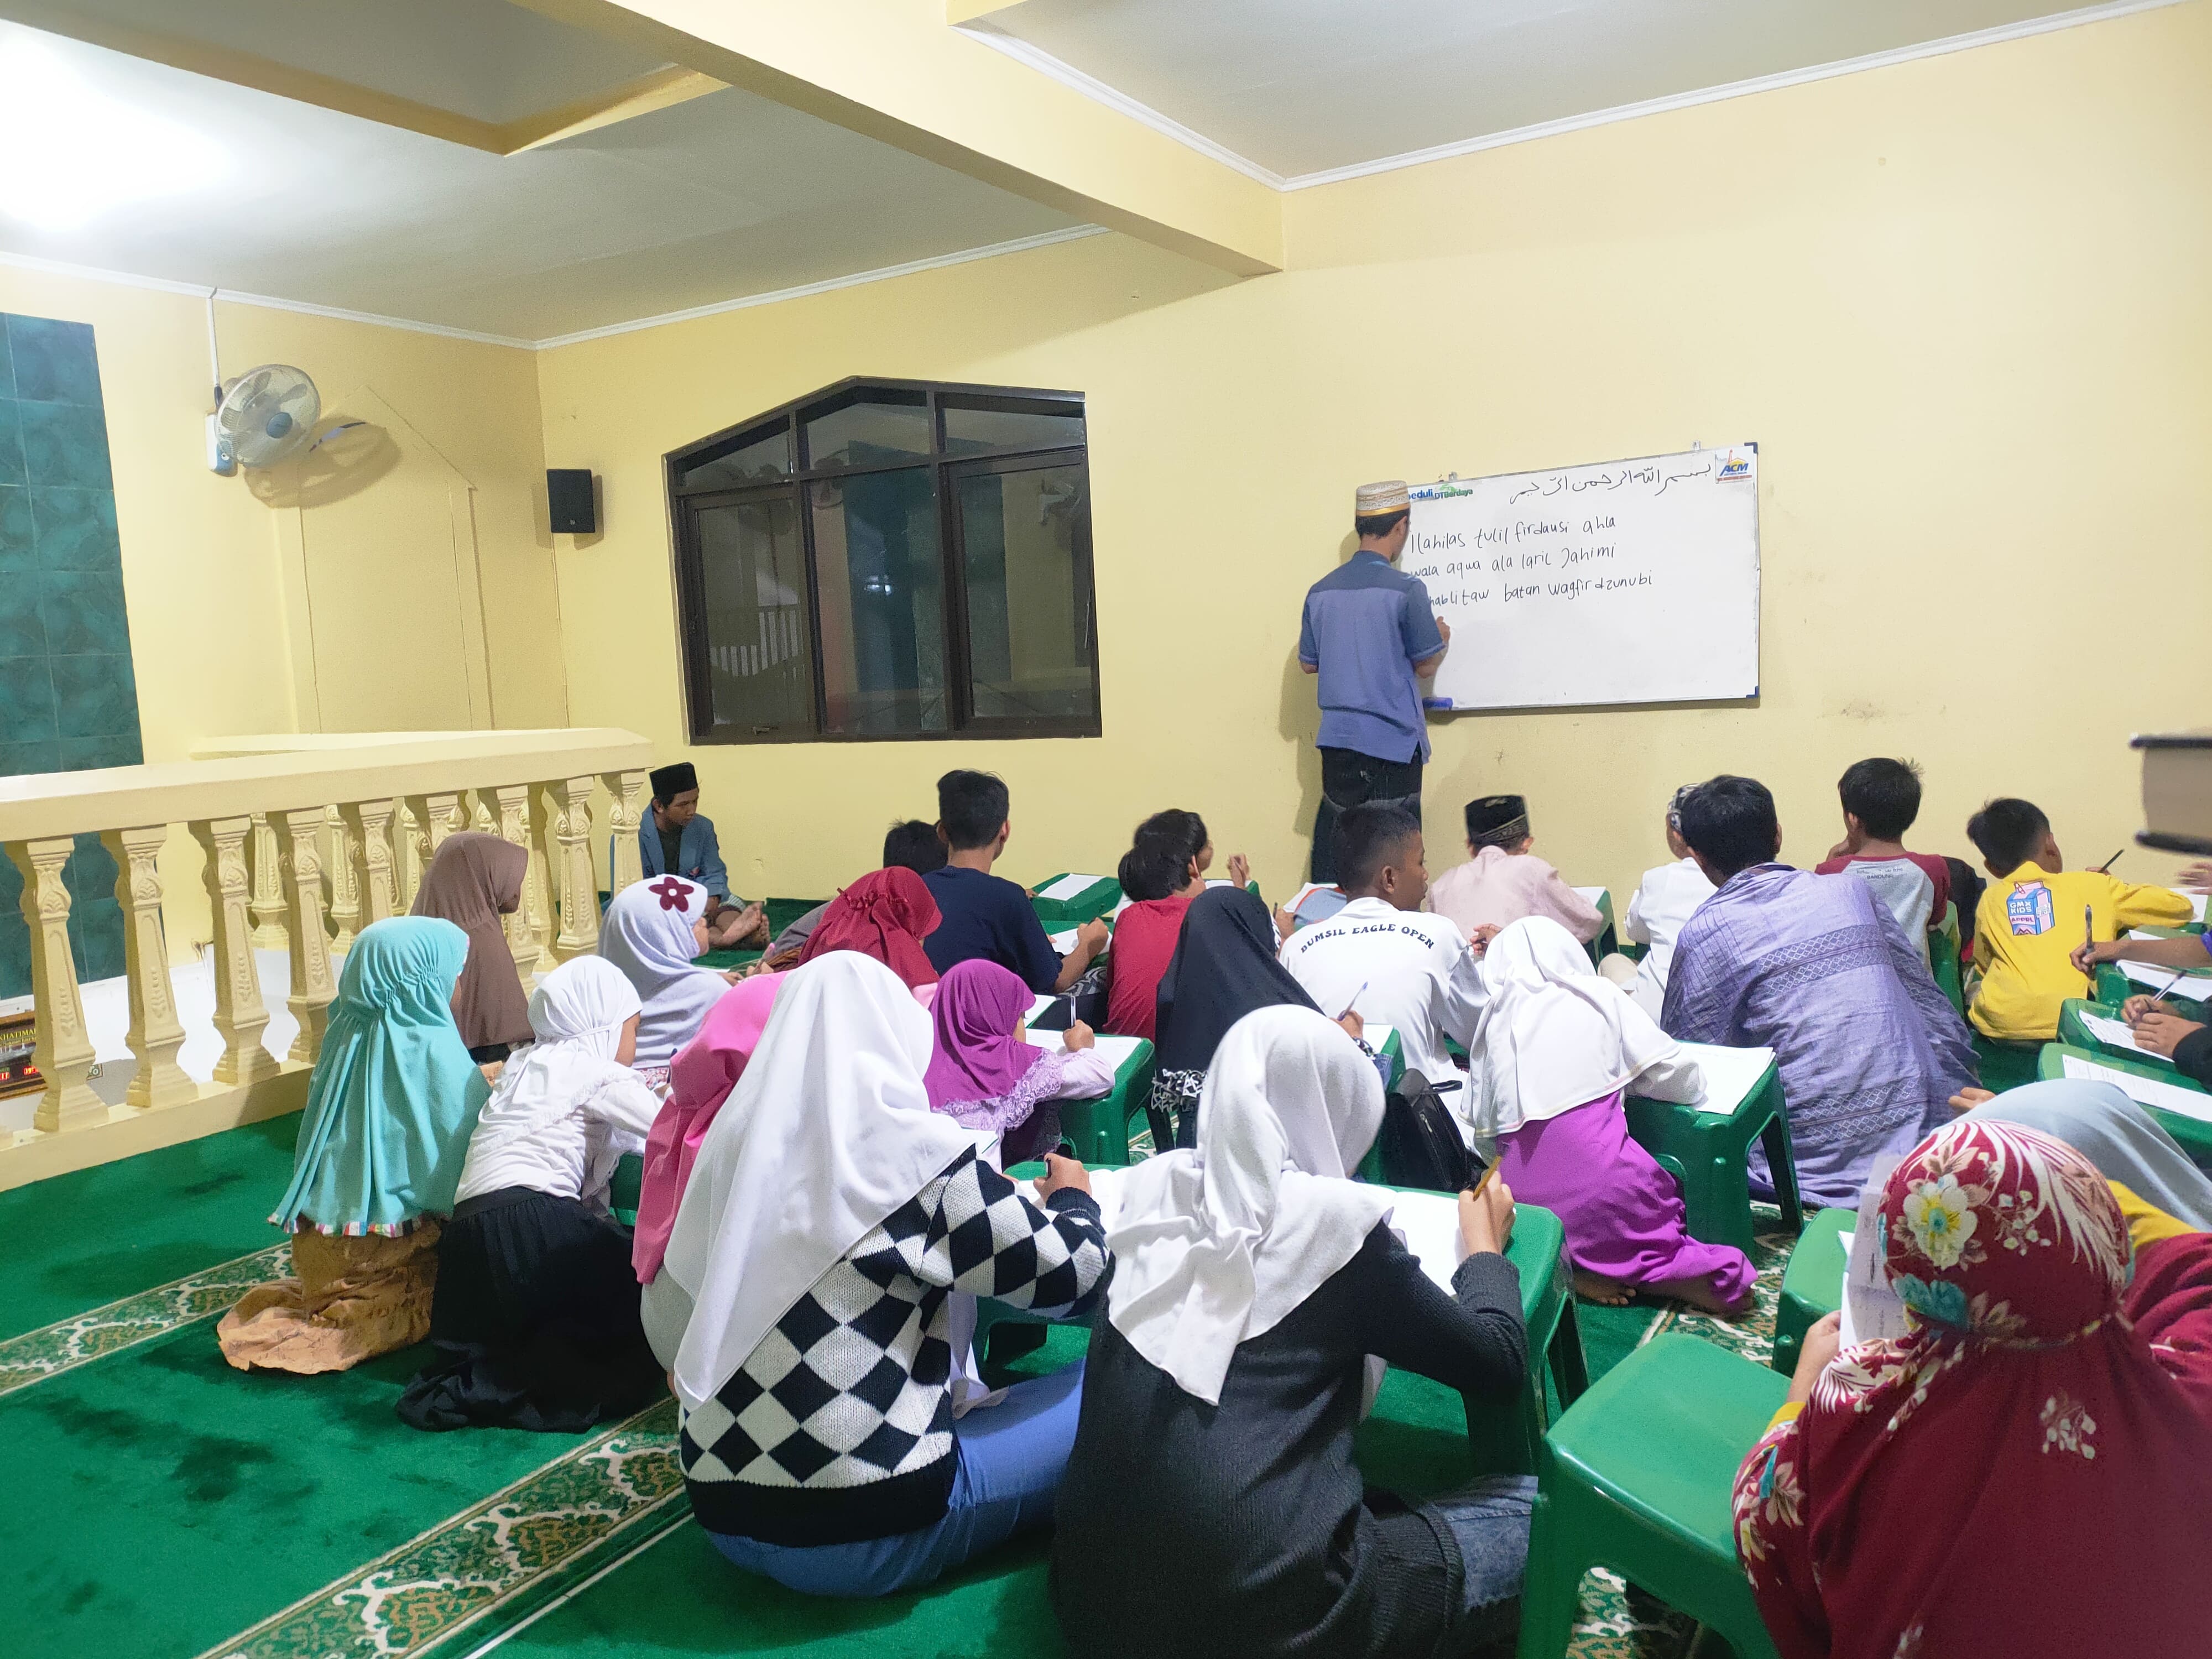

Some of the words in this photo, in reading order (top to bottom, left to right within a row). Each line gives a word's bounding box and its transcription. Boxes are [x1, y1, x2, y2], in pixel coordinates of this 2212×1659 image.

[1719, 463, 1749, 476] ACM
[1515, 521, 1569, 542] firdausi
[1583, 515, 1616, 534] ahla
[1491, 555, 1512, 571] ala
[1505, 583, 1540, 602] batan
[1352, 924, 1396, 934] EAGLE
[1401, 926, 1434, 950] OPEN
